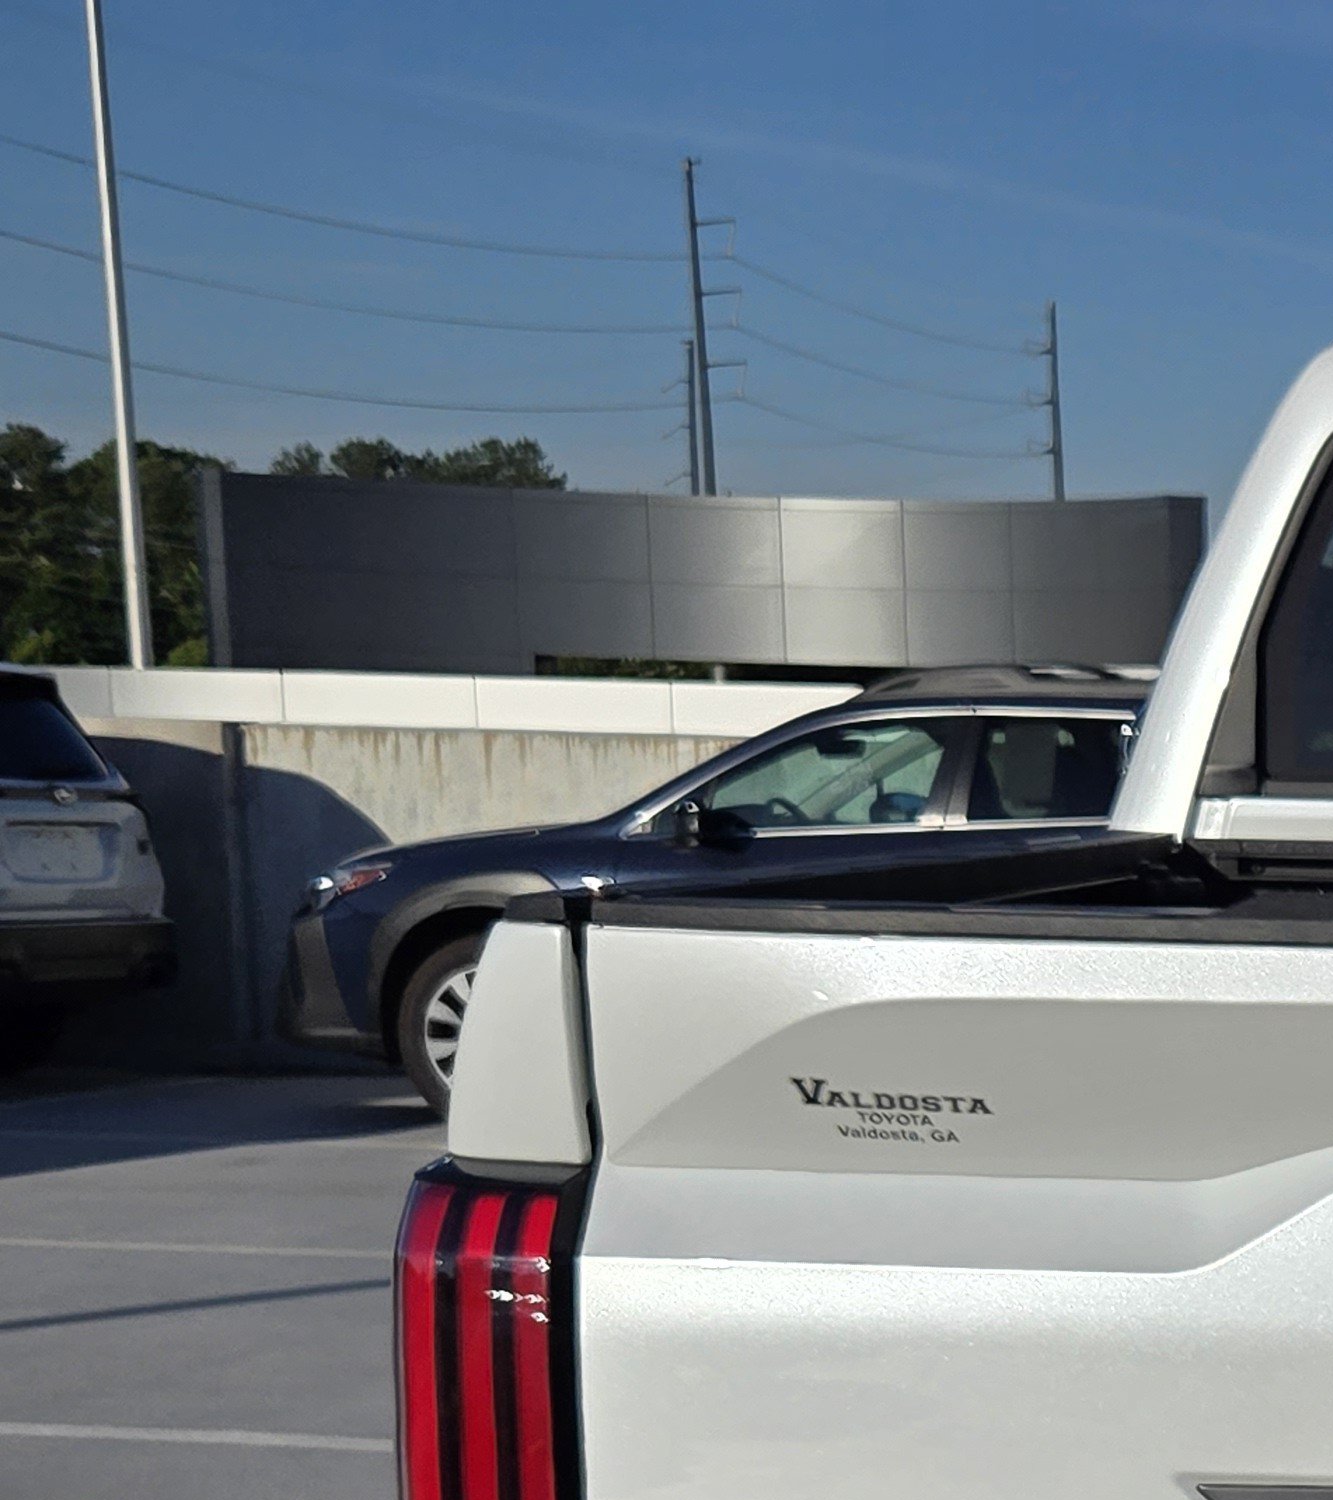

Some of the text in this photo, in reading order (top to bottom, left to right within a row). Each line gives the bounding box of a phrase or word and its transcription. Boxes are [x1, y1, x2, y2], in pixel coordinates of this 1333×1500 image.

[790, 1076, 994, 1115] VALDOSTA
[857, 1110, 935, 1127] TOYOTA
[837, 1124, 961, 1144] Valdosta, GA
